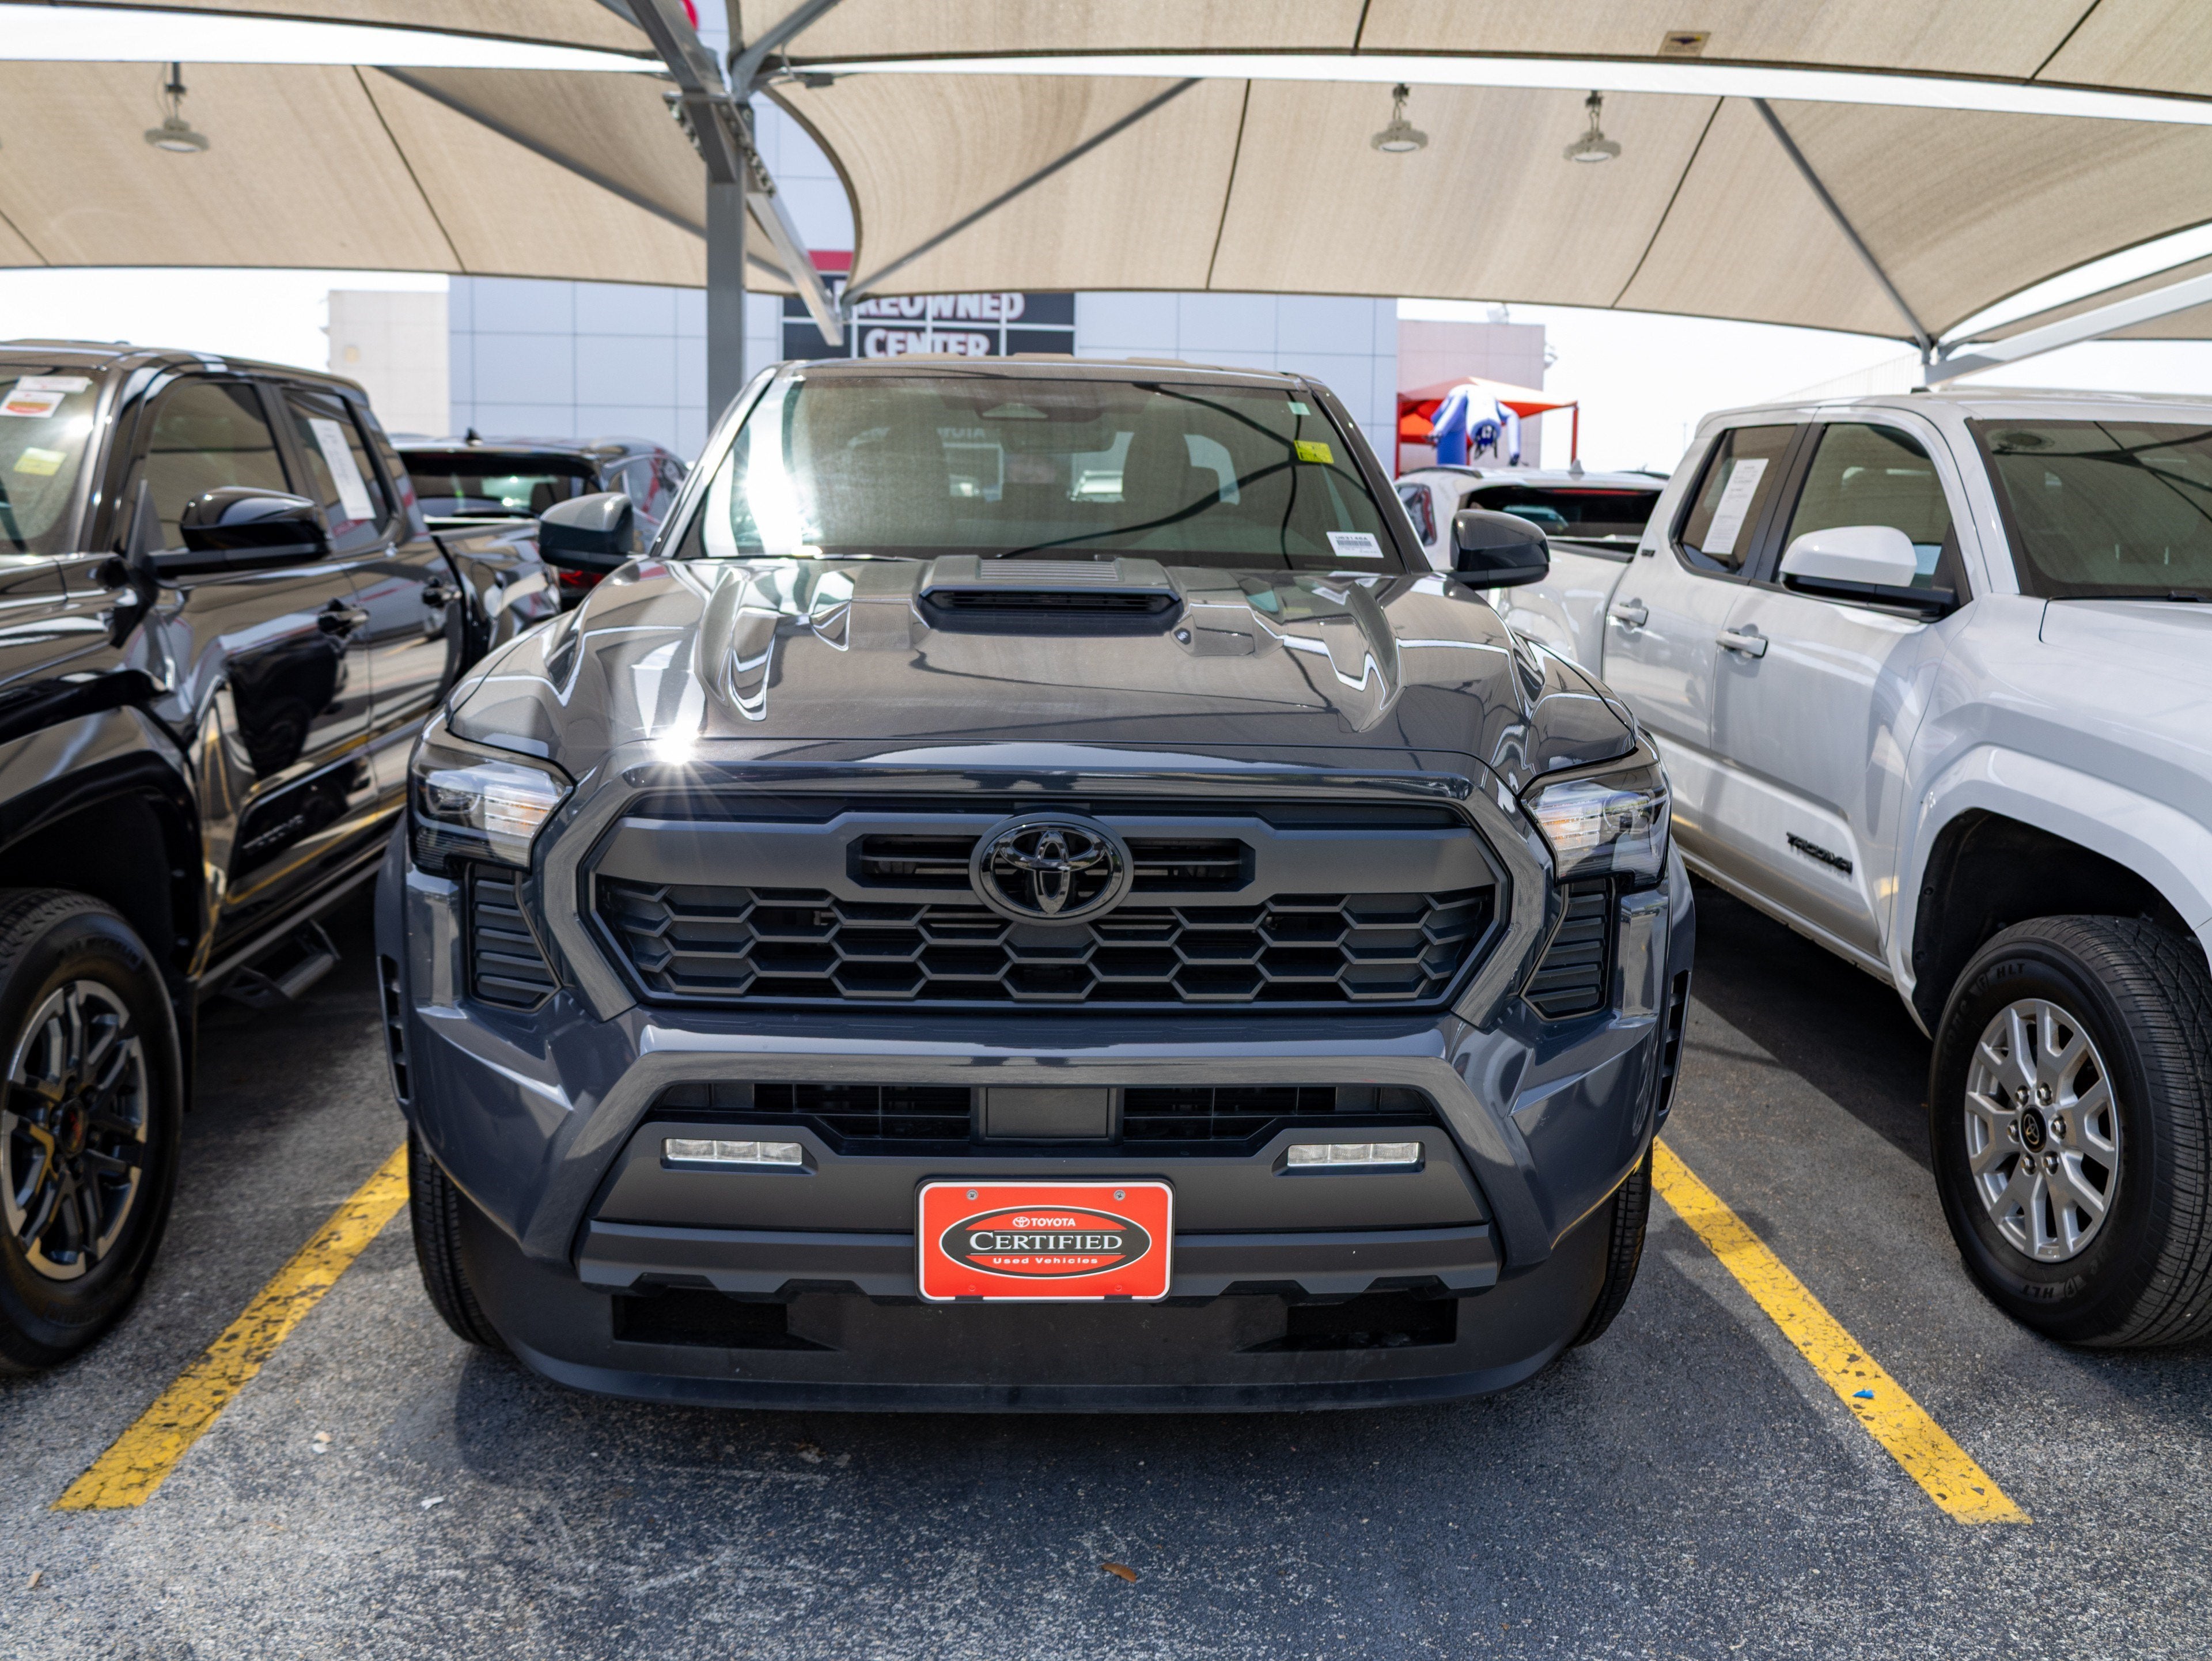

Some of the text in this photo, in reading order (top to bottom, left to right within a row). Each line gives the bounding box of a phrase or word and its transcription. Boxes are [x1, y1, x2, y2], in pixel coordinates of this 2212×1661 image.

[864, 328, 990, 358] CENTER
[1031, 1217, 1076, 1227] TOYOTA
[969, 1232, 1123, 1251] CERTIFIED
